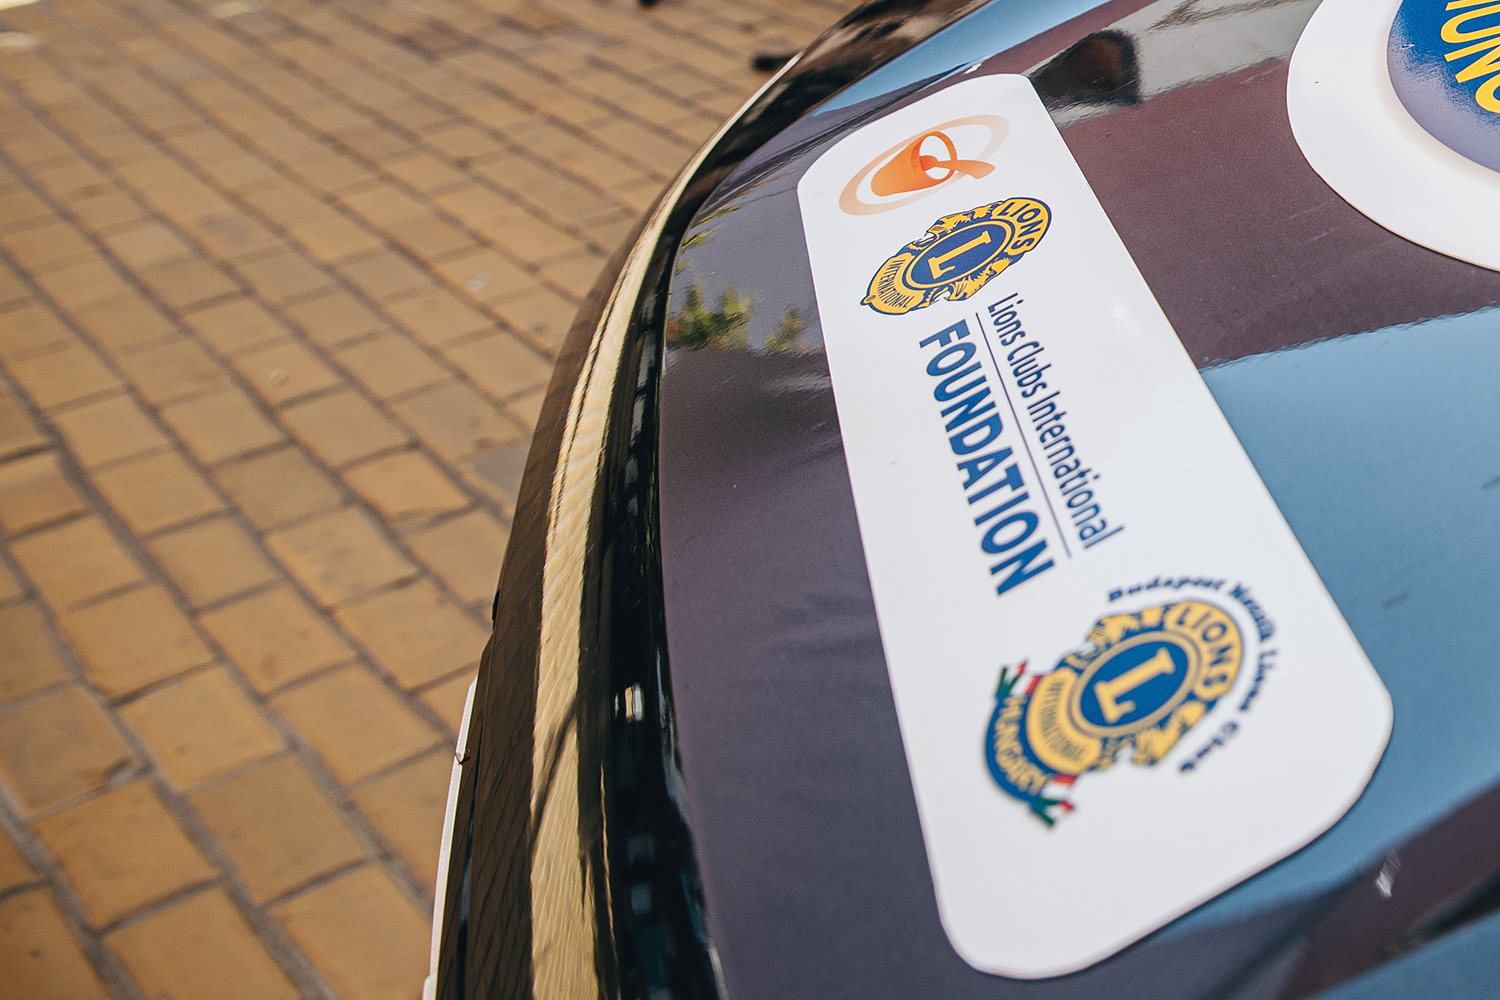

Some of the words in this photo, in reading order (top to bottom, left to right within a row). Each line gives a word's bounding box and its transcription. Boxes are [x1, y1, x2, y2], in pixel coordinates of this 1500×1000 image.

[927, 230, 991, 280] L
[998, 201, 1046, 255] LIONS
[876, 258, 916, 308] INTERNATIONAL
[987, 292, 1025, 347] Lions
[1007, 341, 1052, 398] Clubs
[918, 318, 1056, 596] FOUNDATION
[1026, 390, 1124, 549] International
[1175, 605, 1234, 688] LIONS
[1094, 647, 1176, 723] L
